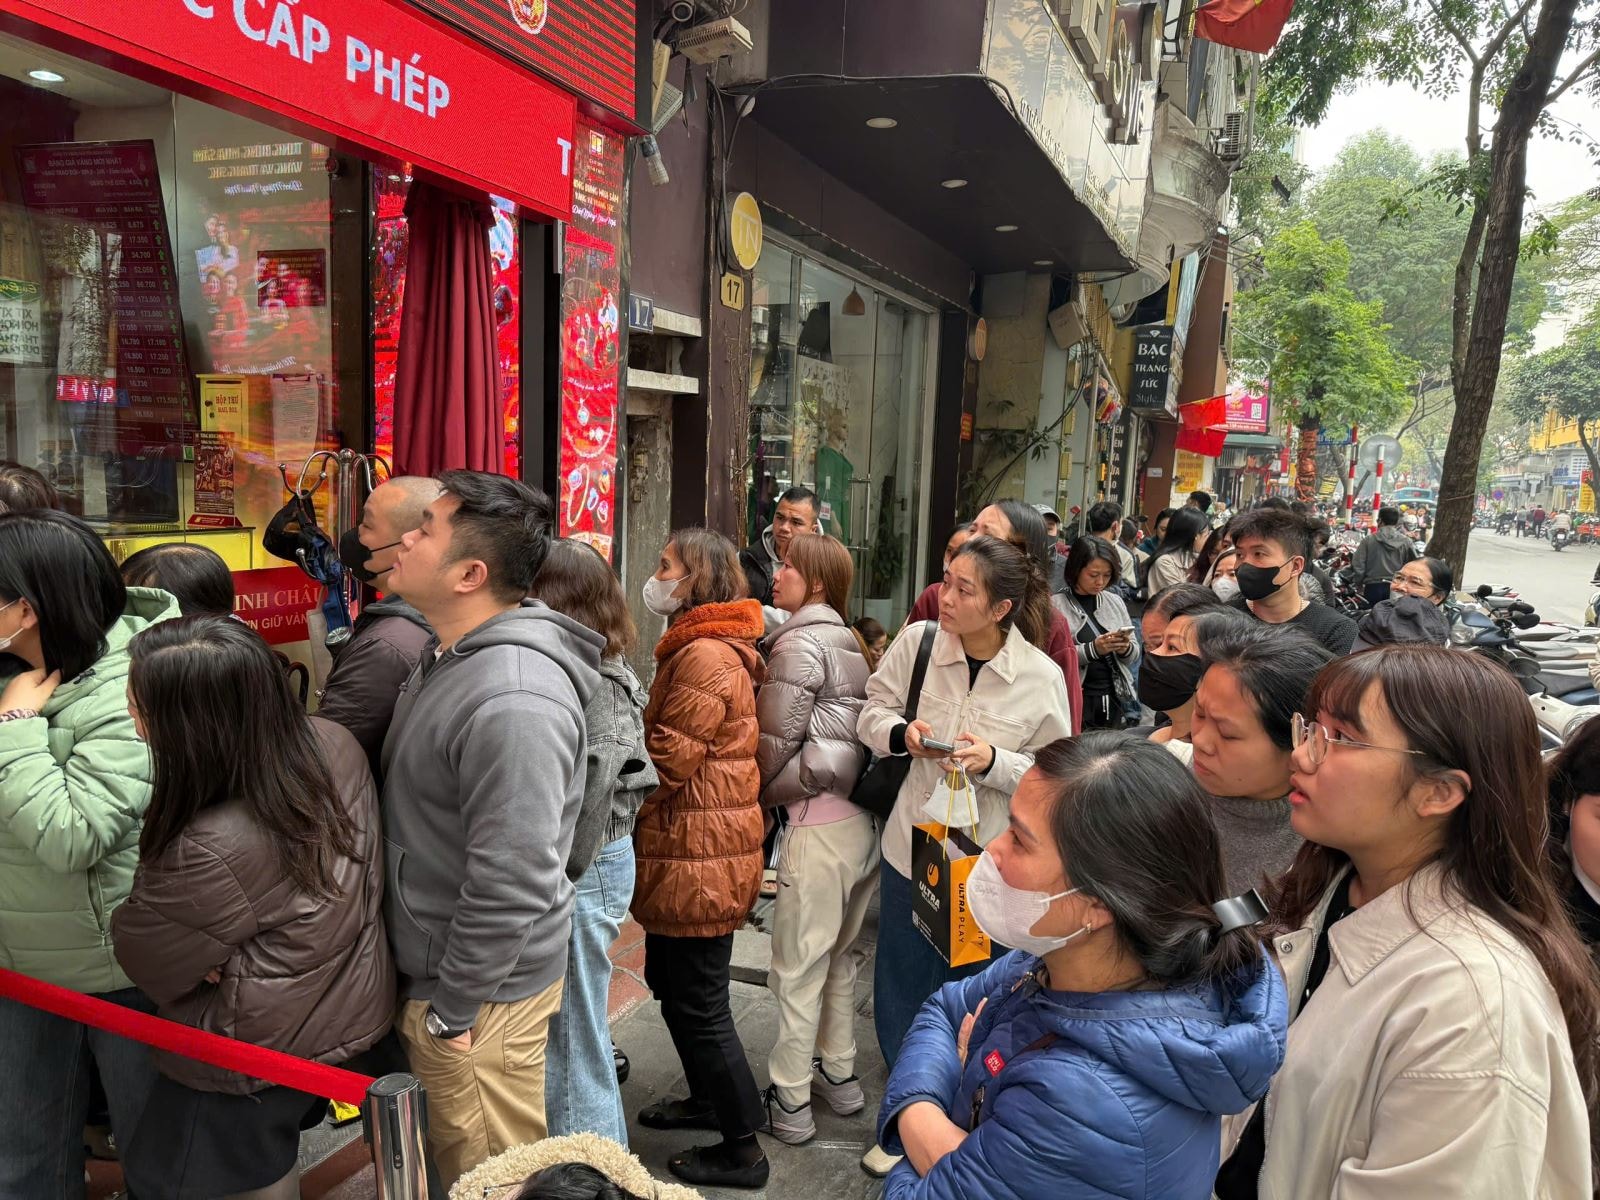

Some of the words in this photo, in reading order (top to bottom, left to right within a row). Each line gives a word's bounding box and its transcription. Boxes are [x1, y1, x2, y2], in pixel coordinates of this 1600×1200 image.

[346, 35, 450, 118] PHÉP
[557, 137, 571, 176] T
[727, 279, 740, 304] 17
[634, 298, 650, 327] 17
[1137, 343, 1168, 359] BẠC
[1135, 364, 1168, 373] TRANG
[1140, 378, 1160, 388] SỨC
[215, 394, 227, 406] HỘP
[227, 394, 239, 405] THƯ
[262, 614, 283, 629] GIỮ
[919, 880, 942, 909] ULTRA
[958, 917, 966, 943] PLAY
